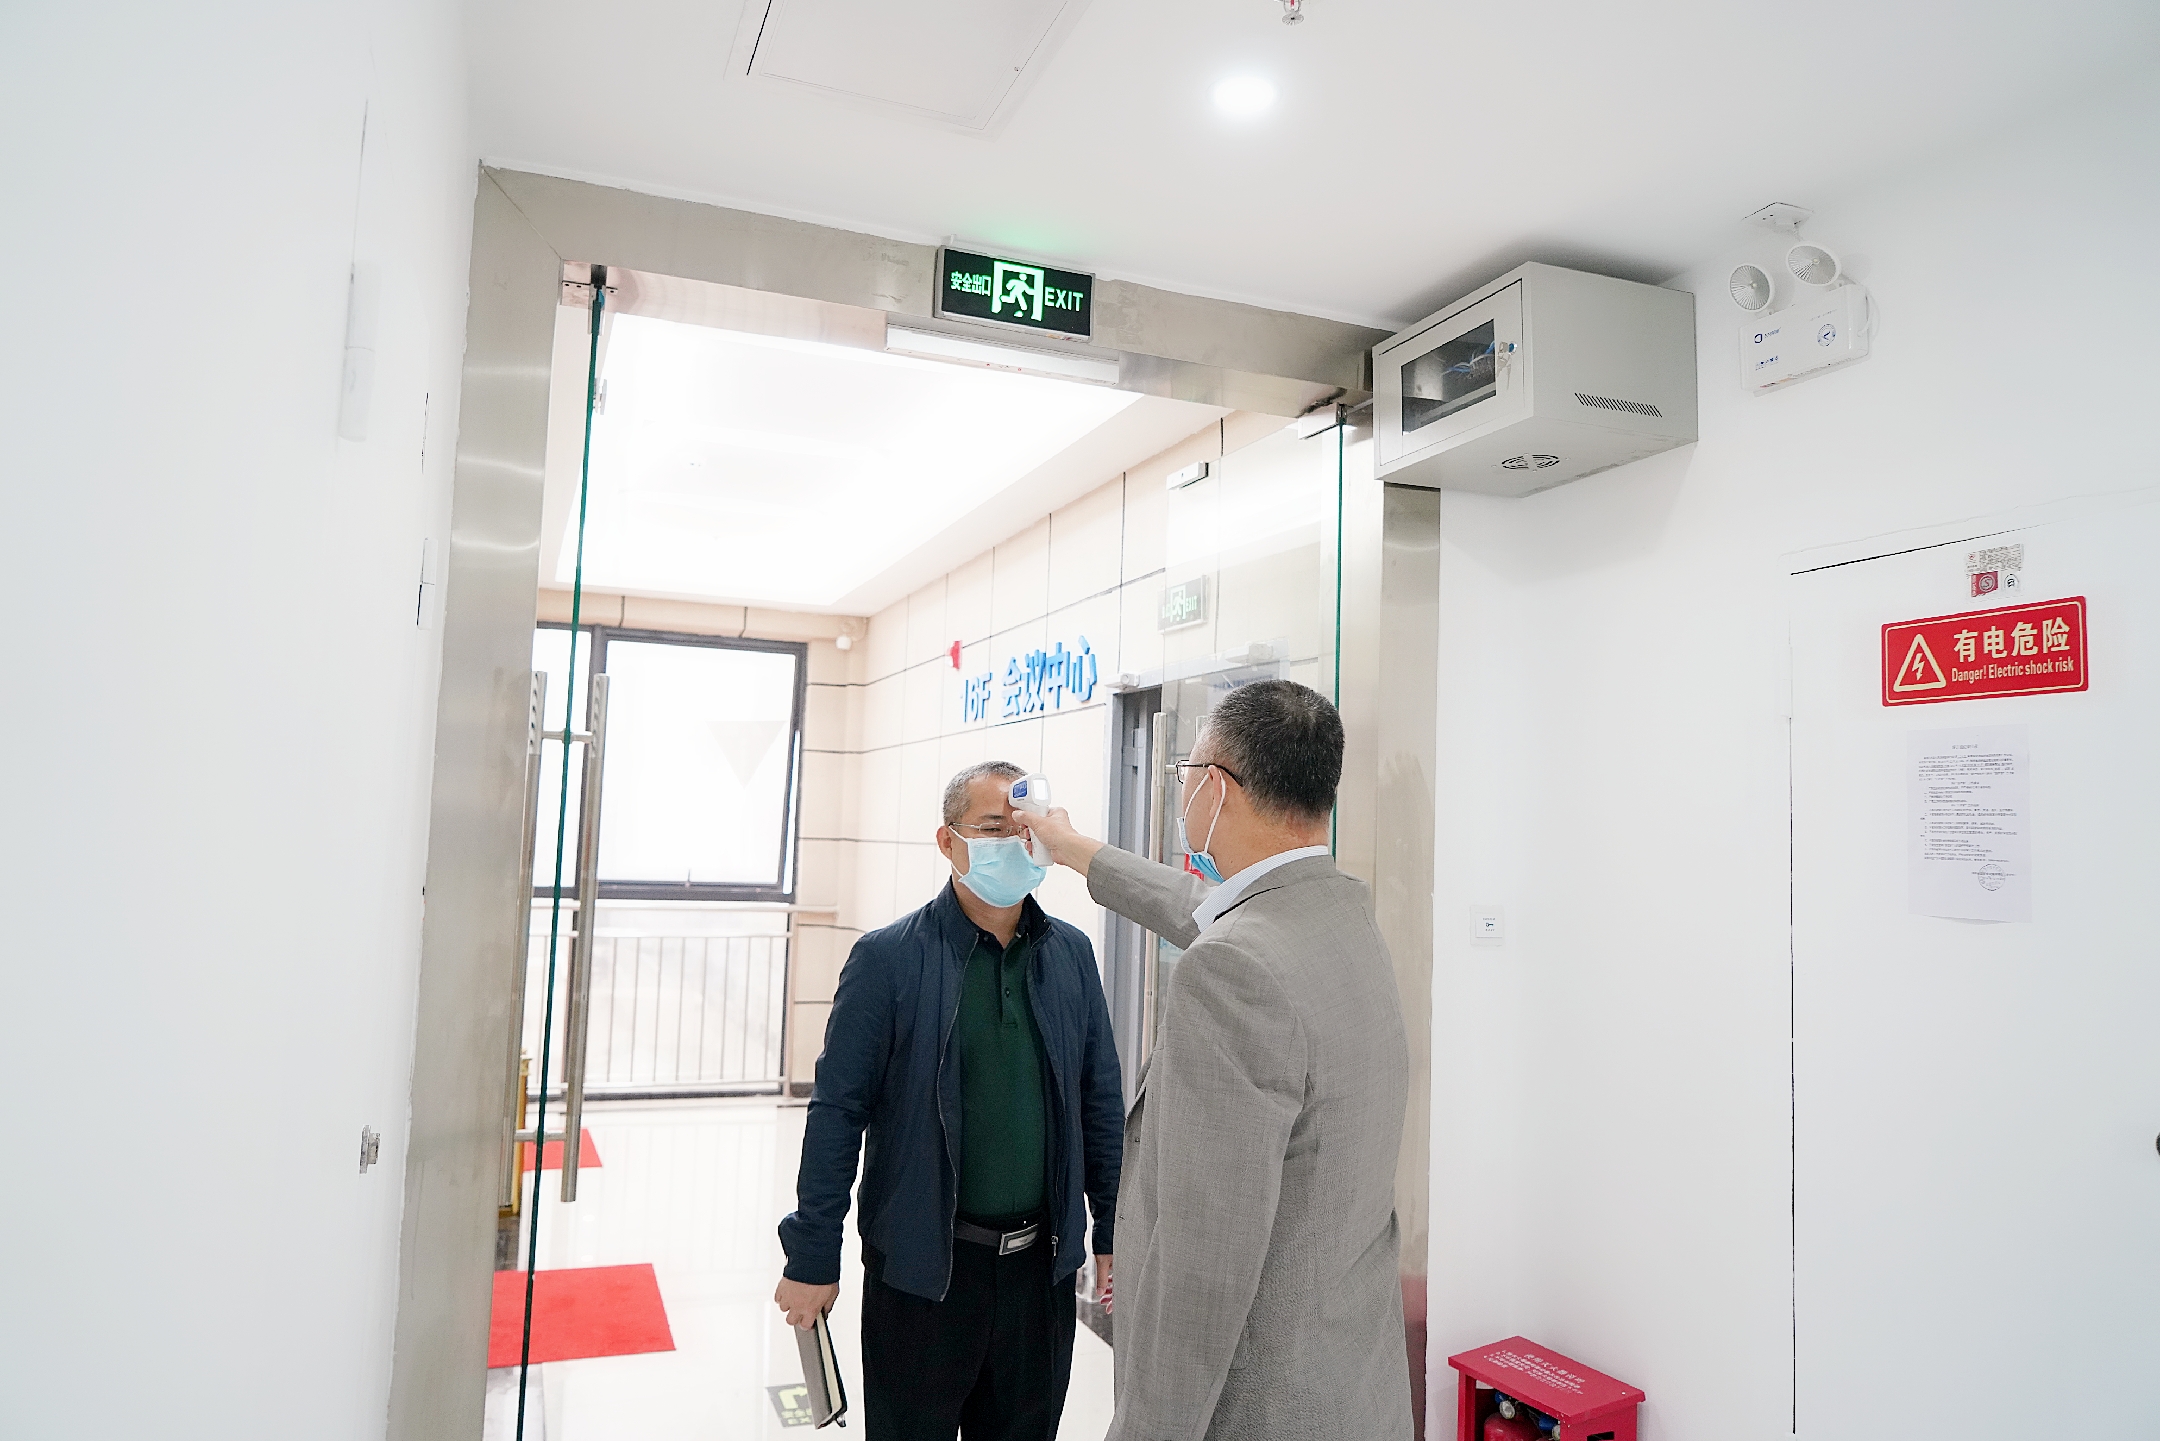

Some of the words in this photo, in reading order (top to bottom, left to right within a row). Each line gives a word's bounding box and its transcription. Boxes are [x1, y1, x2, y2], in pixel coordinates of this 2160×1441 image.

[950, 271, 991, 297] 安全出口
[1044, 286, 1084, 312] EXIT
[1953, 617, 2070, 663] 有电危险
[1001, 635, 1098, 719] 会议中心
[1951, 665, 1987, 684] Danger!
[1988, 661, 2024, 679] Electric
[2024, 658, 2054, 676] shock
[2055, 655, 2074, 673] risk
